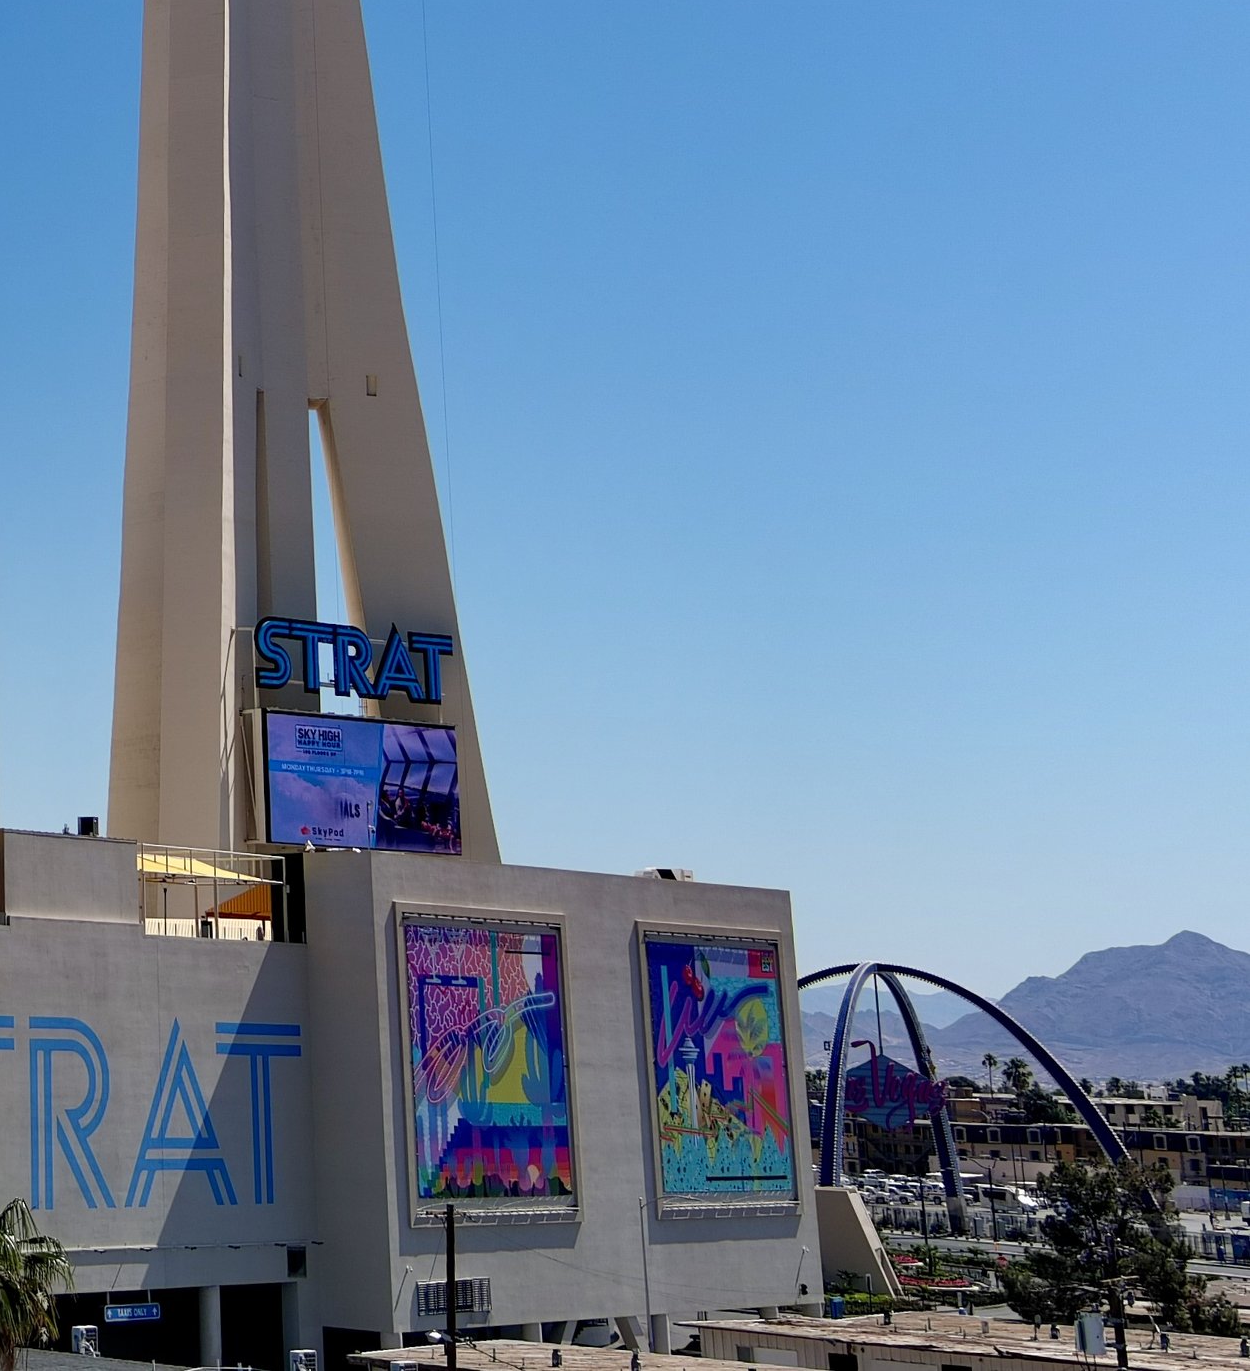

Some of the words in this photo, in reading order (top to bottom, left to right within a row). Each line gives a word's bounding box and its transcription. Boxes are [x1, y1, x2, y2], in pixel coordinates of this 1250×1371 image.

[254, 616, 453, 705] STRAT
[297, 727, 316, 739] SKY
[318, 729, 340, 742] HIGH
[297, 739, 319, 747] HAPPY
[322, 741, 340, 749] HOUR
[281, 763, 305, 771] MONDAY
[306, 764, 335, 774] THURSDAY
[311, 826, 345, 837] SkyPod
[851, 1039, 948, 1135] Vegas
[133, 1307, 147, 1317] ONLY
